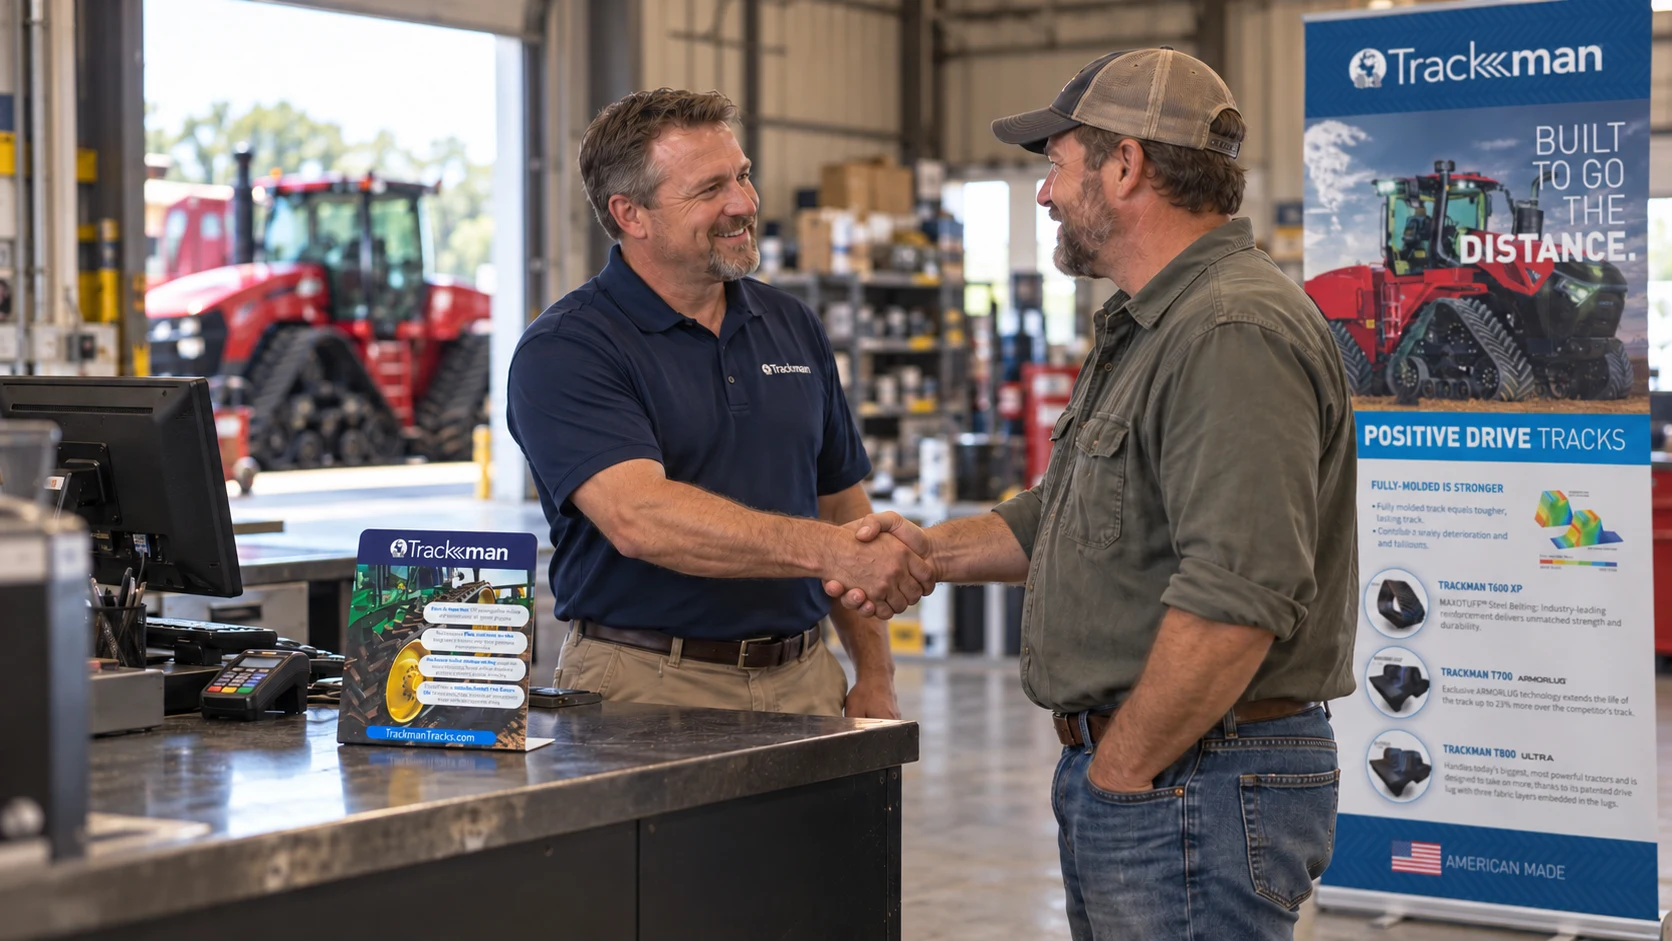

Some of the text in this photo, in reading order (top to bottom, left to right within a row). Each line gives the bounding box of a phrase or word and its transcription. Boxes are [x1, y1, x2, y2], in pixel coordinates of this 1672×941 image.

[1536, 122, 1626, 156] BUILT
[1532, 158, 1624, 190] TO GO
[1563, 194, 1625, 225] THE
[1460, 230, 1636, 264] DISTANCE.
[770, 363, 811, 374] Trackman
[1364, 425, 1626, 451] POSITIVE DRIVE TRACKS
[1371, 480, 1504, 493] FULLY-MOLDED IS STRONGER
[1376, 502, 1394, 512] Fully
[1396, 504, 1424, 512] molded
[1426, 505, 1446, 513] track
[1475, 507, 1507, 517] tougher,
[1403, 516, 1424, 524] track.
[1443, 530, 1492, 539] deterioration
[1493, 532, 1508, 540] and
[1378, 540, 1392, 548] and
[1438, 581, 1523, 593] TRACKMAN T600 XP
[1488, 600, 1507, 609] Steel
[1540, 604, 1606, 616] Industry-leading
[1440, 611, 1622, 628] reinforcement delivers unmatched strength and
[1440, 621, 1481, 632] durability.
[1441, 667, 1566, 684] TRACKMAN T700 ARMORLUG
[1442, 685, 1629, 704] Exclusive ARMORLUG technology extends the life of
[1456, 698, 1473, 706] track
[1475, 700, 1484, 708] up
[1495, 700, 1511, 708] 23%
[1552, 704, 1564, 712] the
[1566, 706, 1612, 715] competitor's
[1614, 708, 1635, 717] track.
[386, 728, 475, 742] TrackmanTracks.com
[1443, 744, 1554, 761] TRACKMAN T800 ULTRA
[1474, 764, 1499, 775] today's
[1500, 767, 1529, 777] biggest,
[1551, 772, 1583, 781] powerful
[1584, 774, 1614, 783] tractors
[1615, 777, 1629, 785] and
[1444, 774, 1475, 784] designed
[1486, 777, 1501, 786] take
[1513, 781, 1533, 790] more,
[1534, 782, 1559, 791] thanks
[1561, 784, 1568, 792] to
[1580, 786, 1612, 795] patented
[1613, 788, 1632, 797] drive
[1445, 785, 1619, 809] lug with three fabric layers embedded in the lugs.
[1446, 855, 1566, 880] AMERICAN MADE
